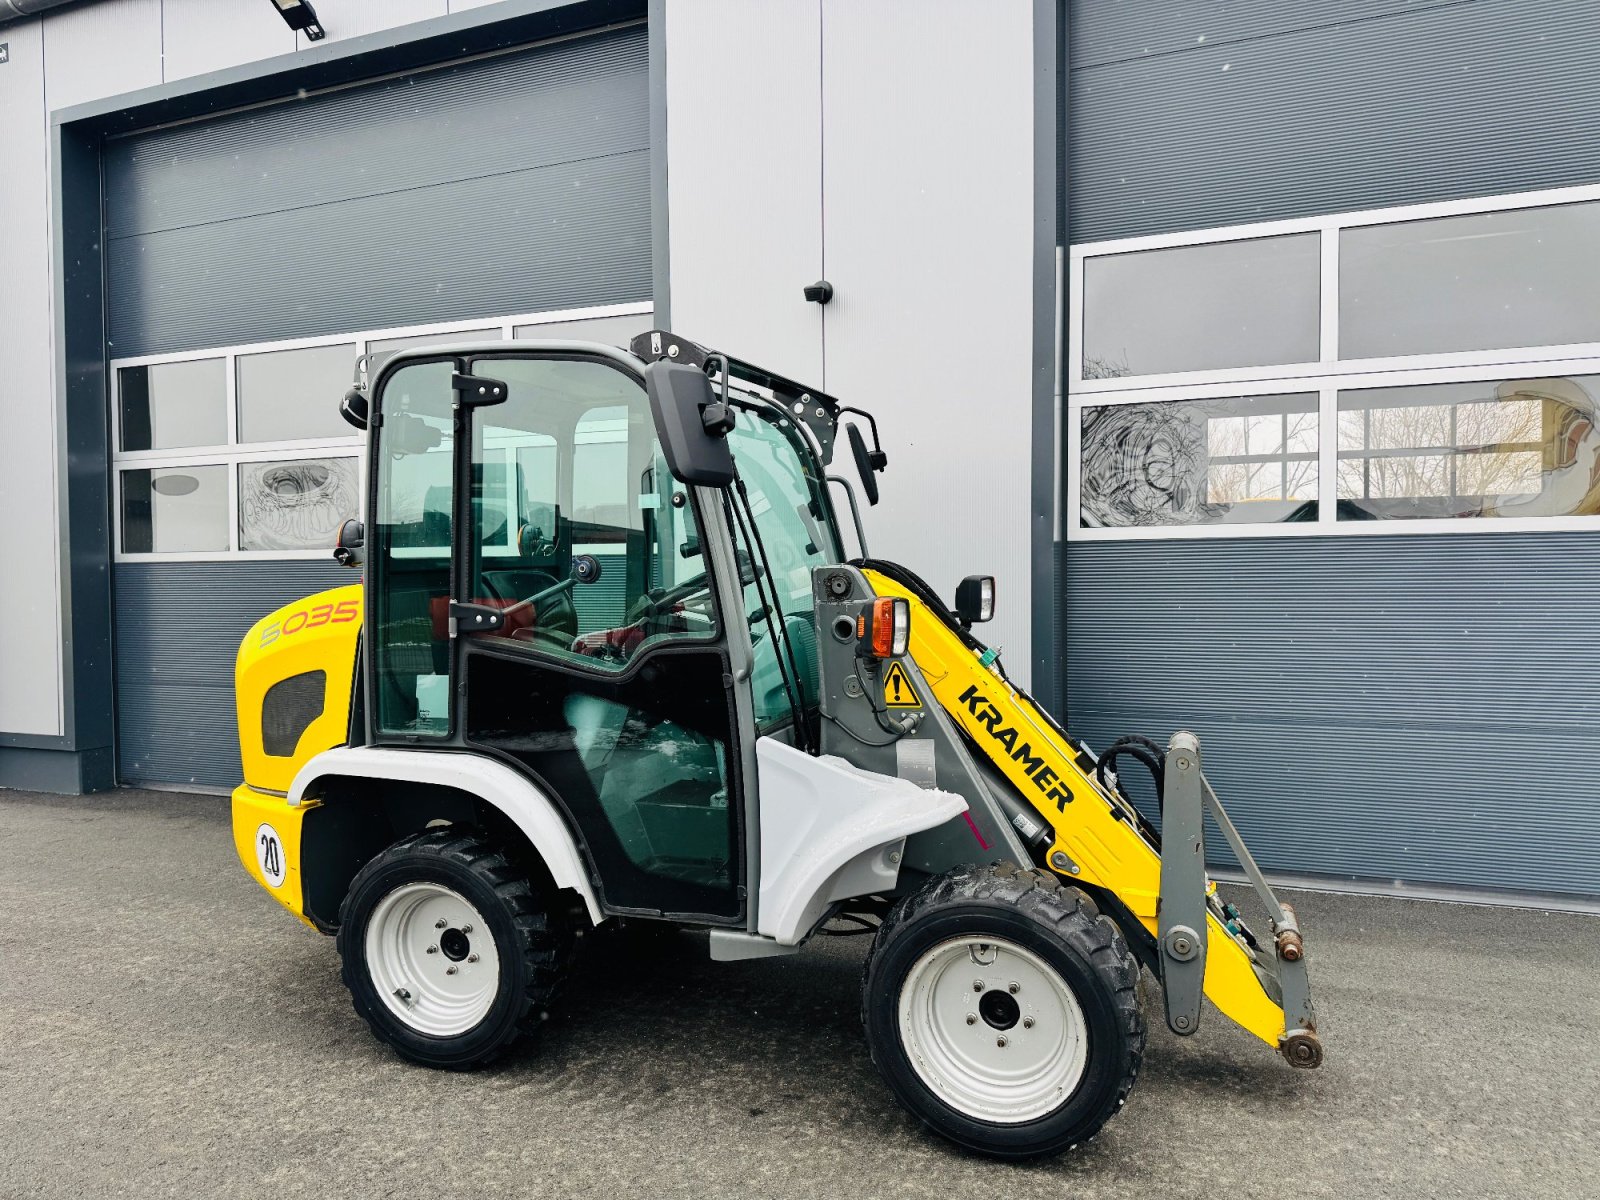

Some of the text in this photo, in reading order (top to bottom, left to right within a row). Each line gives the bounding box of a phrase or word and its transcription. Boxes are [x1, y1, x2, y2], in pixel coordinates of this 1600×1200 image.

[259, 600, 360, 648] 5035
[958, 684, 1075, 814] KRAMER
[261, 834, 280, 877] 20
